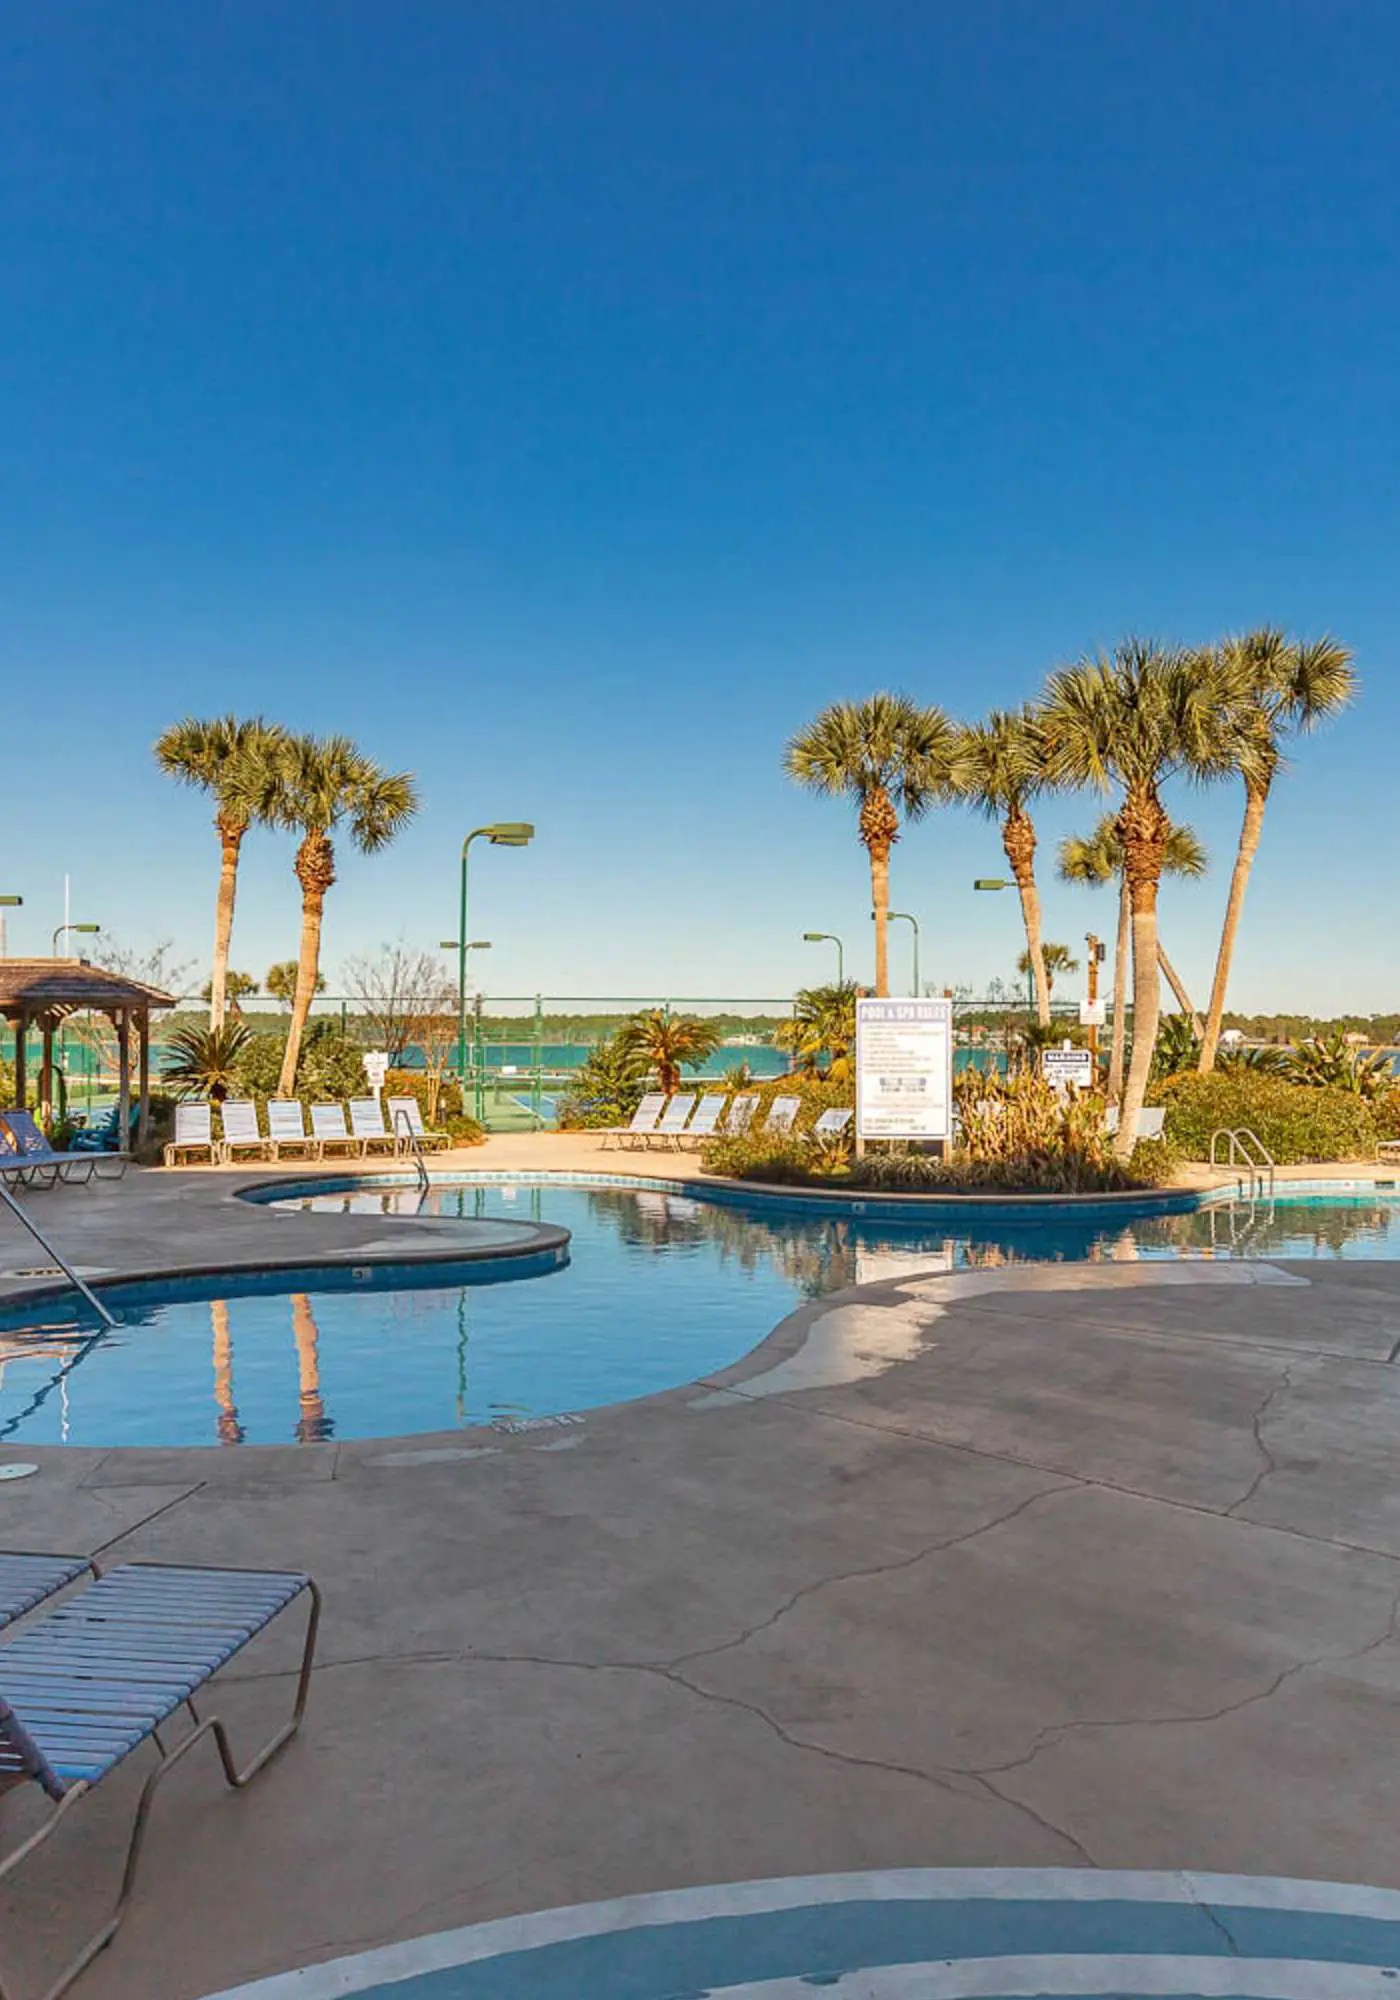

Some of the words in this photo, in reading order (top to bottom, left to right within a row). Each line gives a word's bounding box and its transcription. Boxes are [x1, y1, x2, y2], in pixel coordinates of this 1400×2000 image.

[861, 1005, 885, 1019] POOL
[897, 1005, 915, 1019] SPA
[917, 1005, 946, 1019] RULES
